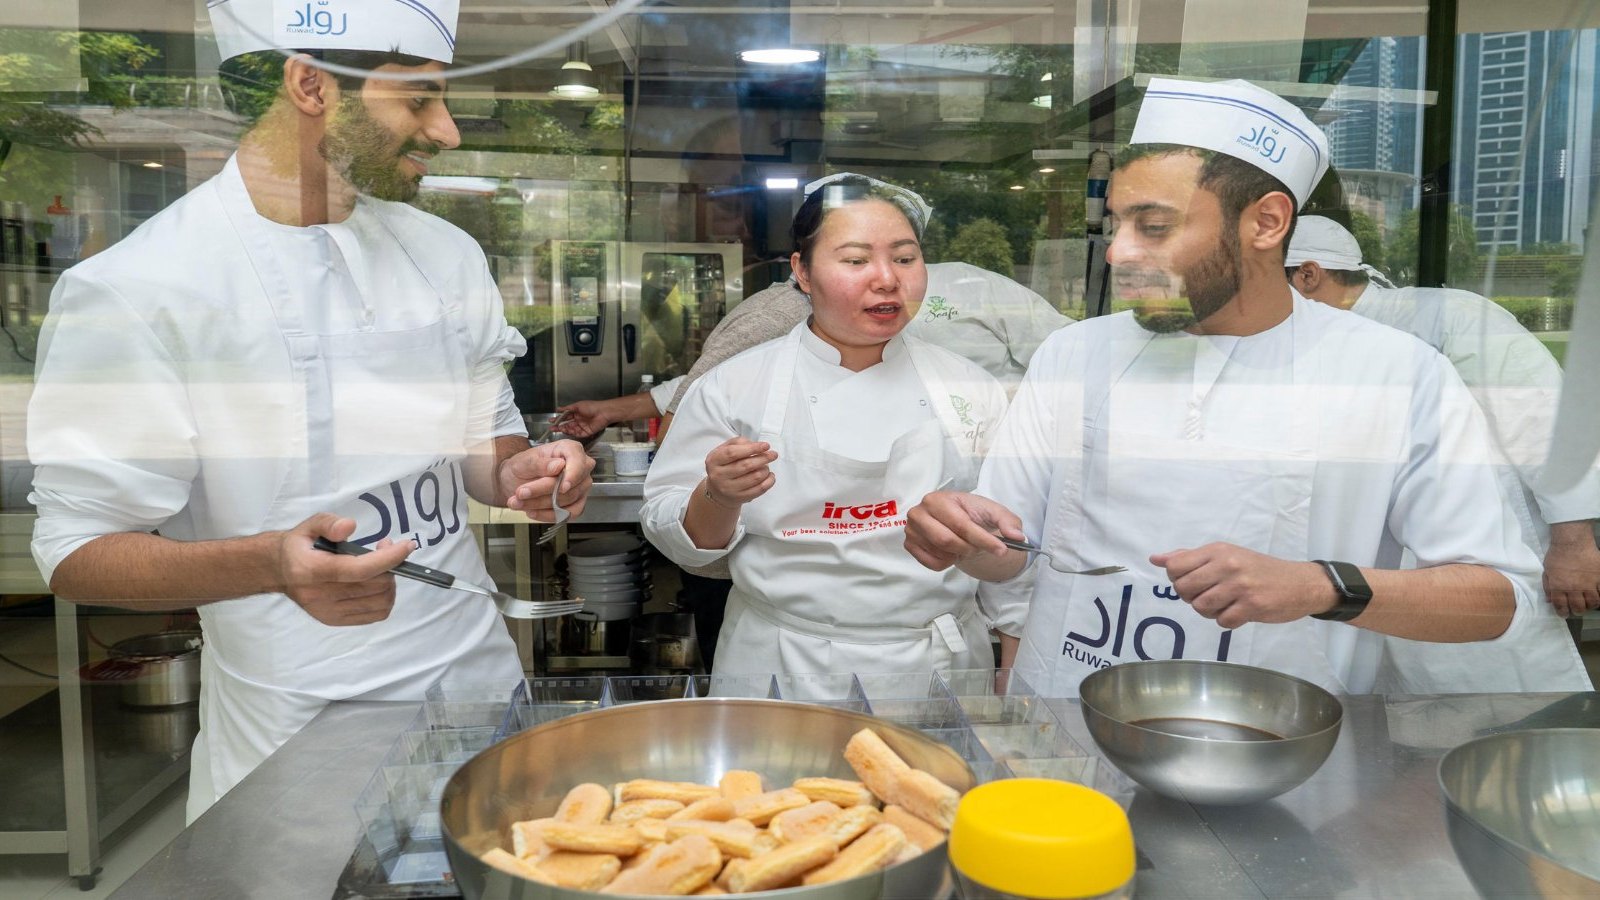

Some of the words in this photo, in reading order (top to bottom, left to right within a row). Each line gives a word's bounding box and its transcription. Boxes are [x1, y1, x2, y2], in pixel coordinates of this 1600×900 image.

[822, 500, 898, 519] irca
[782, 529, 798, 537] Your
[1063, 641, 1111, 669] Ruwa
